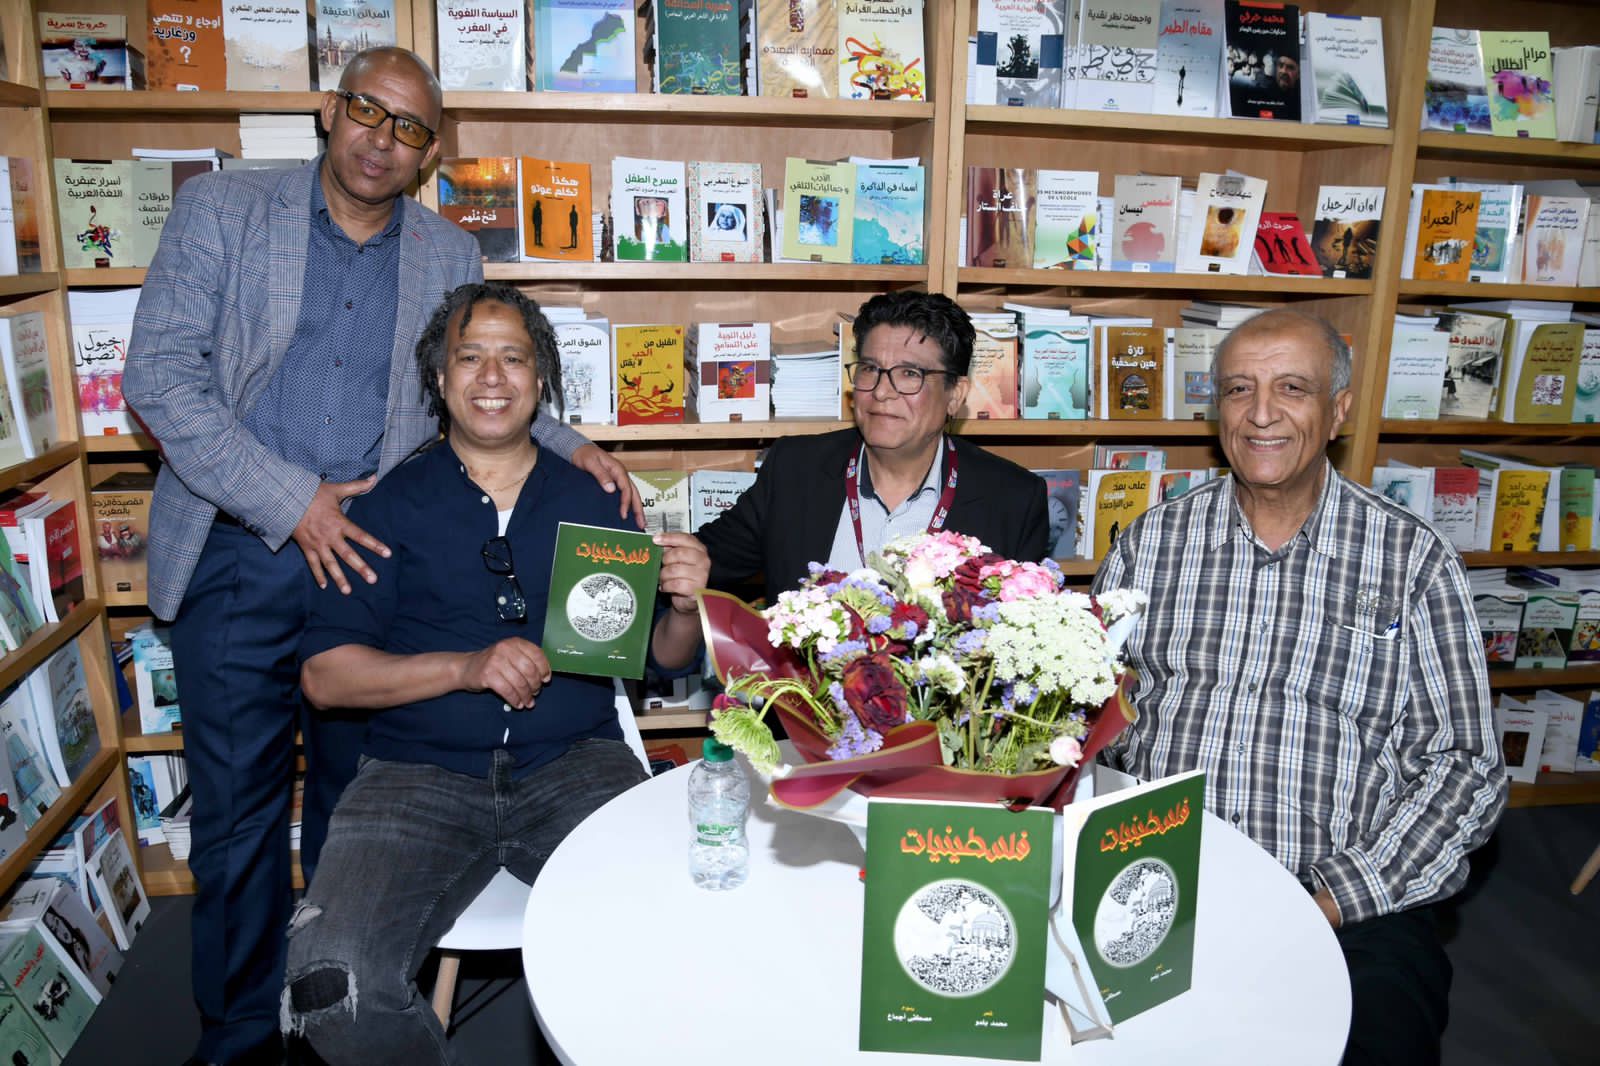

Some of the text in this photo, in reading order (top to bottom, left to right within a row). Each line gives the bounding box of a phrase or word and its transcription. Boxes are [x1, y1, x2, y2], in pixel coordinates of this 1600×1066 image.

[186, 15, 193, 25] لا
[448, 8, 518, 20] السياسة اللغوية
[153, 25, 197, 42] وزغاريد
[458, 23, 508, 38] في المغرب
[64, 175, 97, 187] عبقرية
[625, 174, 651, 185] الطفل
[85, 333, 121, 351] خيول
[575, 542, 651, 565] فلسطينيات
[1100, 797, 1191, 852] فلسطينيات
[900, 825, 1031, 864] فلسطينيات
